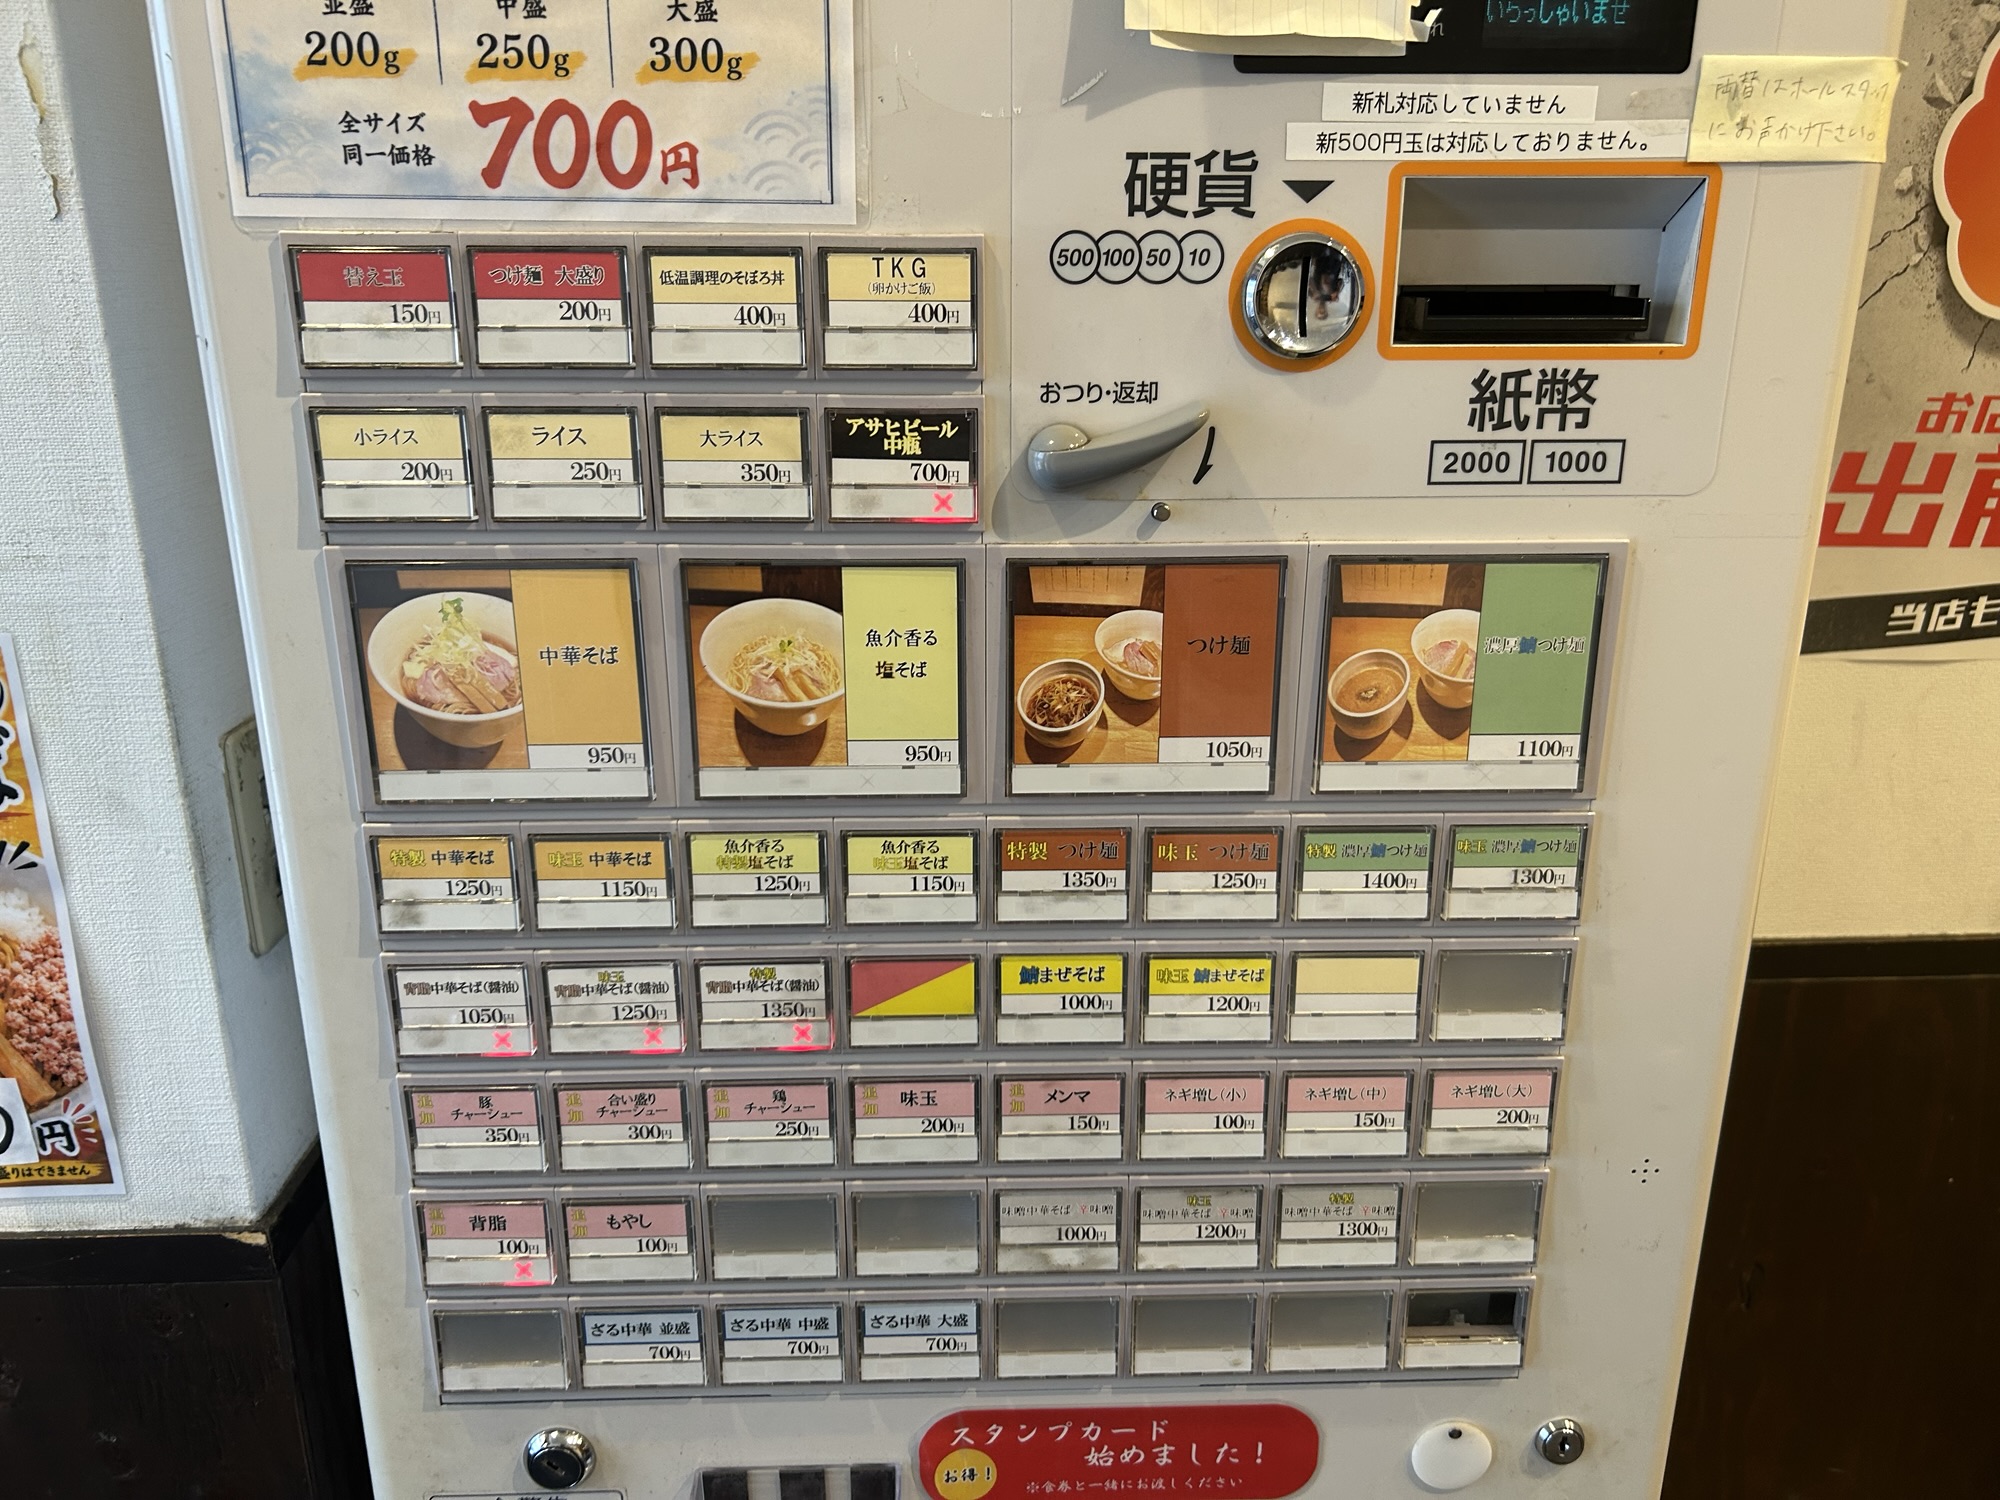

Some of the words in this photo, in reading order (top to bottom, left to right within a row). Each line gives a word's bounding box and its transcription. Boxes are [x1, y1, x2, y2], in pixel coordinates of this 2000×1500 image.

[304, 30, 401, 75] 200g
[476, 33, 570, 78] 250g
[649, 36, 743, 81] 300g
[1352, 91, 1566, 115] 新札対応していません
[338, 111, 426, 135] 全サイズ
[469, 97, 700, 190] 700円
[1316, 131, 1649, 154] 新500円玉は対応しておりません。
[342, 143, 436, 168] 同一価格
[1124, 149, 1259, 218] 硬貨
[1056, 248, 1094, 267] 500
[1102, 248, 1135, 267] 100
[1145, 248, 1171, 267] 50
[1189, 248, 1211, 267] 10
[342, 266, 405, 287] 替え玉
[489, 264, 543, 285] つけ麺
[555, 265, 605, 286] 大盛り
[871, 257, 927, 279] TKG
[659, 269, 785, 286] 低温調理のそぼろ丼
[390, 303, 441, 324] 150円
[558, 301, 611, 321] 200円
[733, 305, 786, 326] 400円
[907, 303, 960, 324] 400円
[1040, 381, 1158, 404] おつり・返却
[1467, 367, 1599, 432] 紙幣
[531, 426, 587, 447] ライス
[846, 418, 959, 438] アサヒビール
[353, 428, 419, 446] 小ライス
[699, 429, 764, 448] 大ライス
[884, 436, 922, 456] 中瓶
[1443, 451, 1510, 474] 2000
[1546, 451, 1607, 473] 1000
[401, 462, 453, 481] 200円
[570, 462, 622, 481] 250円
[741, 463, 791, 483] 350円
[910, 463, 960, 483] 700円
[865, 627, 939, 648] 魚介香る
[1187, 635, 1251, 656] つけ麺
[539, 645, 619, 667] 中華そば
[875, 660, 927, 680] 塩そば
[588, 746, 637, 765] 950円
[904, 745, 952, 763] 950円
[1205, 740, 1263, 759] 1050円
[1516, 740, 1574, 758] 1100円
[724, 839, 785, 854] 魚介香る
[881, 840, 940, 854] 魚介香る
[1007, 842, 1048, 861] 特製
[1058, 841, 1119, 860] つけ麺
[1157, 844, 1198, 862] 味玉
[1209, 842, 1269, 861] つけ麺
[1306, 843, 1336, 859] 特製
[1457, 839, 1487, 854] 味玉
[390, 849, 426, 867] 特製
[432, 849, 495, 866] 中華そば
[549, 852, 583, 867] 味玉
[589, 851, 652, 867] 中華そば
[754, 875, 810, 892] 1250円
[910, 875, 965, 892] 1150円
[1062, 871, 1117, 888] 1350円
[1212, 872, 1266, 889] 1250円
[1362, 872, 1417, 889] 1400円
[1510, 868, 1565, 885] 1300円
[445, 879, 503, 896] 1250円
[600, 881, 658, 897] 1150円
[761, 1002, 816, 1018] 1350円
[1059, 994, 1112, 1010] 1000円
[1207, 996, 1260, 1012] 1200円
[459, 1008, 515, 1024] 1050円
[612, 1005, 667, 1021] 1250円
[607, 1093, 656, 1106] 合い盛り
[900, 1090, 938, 1107] 味玉
[1044, 1088, 1091, 1105] メンマ
[450, 1108, 523, 1121] チャーシュー
[596, 1105, 668, 1118] チャーシュー
[744, 1102, 816, 1116] チャーシュー
[1496, 1109, 1539, 1125] 200円
[775, 1121, 820, 1136] 250円
[921, 1117, 965, 1133] 200円
[1067, 1115, 1110, 1131] 150円
[1213, 1114, 1255, 1129] 100円
[1353, 1112, 1395, 1128] 150円
[485, 1127, 530, 1143] 350円
[627, 1124, 672, 1140] 300円
[469, 1215, 507, 1232] 背脂
[606, 1215, 653, 1230] もやし
[1337, 1222, 1388, 1237] 1300円
[1056, 1226, 1106, 1241] 1000円
[1195, 1224, 1246, 1239] 1200円
[497, 1240, 540, 1255] 100円
[636, 1238, 678, 1254] 100円
[590, 1322, 652, 1337] ざる中華
[659, 1321, 692, 1335] 並盛
[730, 1317, 792, 1332] ざる中華
[798, 1317, 830, 1331] 中盛
[870, 1314, 931, 1329] ざる中華
[937, 1313, 969, 1328] 大盛
[649, 1345, 691, 1360] 700円
[787, 1340, 829, 1355] 700円
[926, 1337, 967, 1352] 700円
[949, 1420, 1169, 1446] スタンプカード
